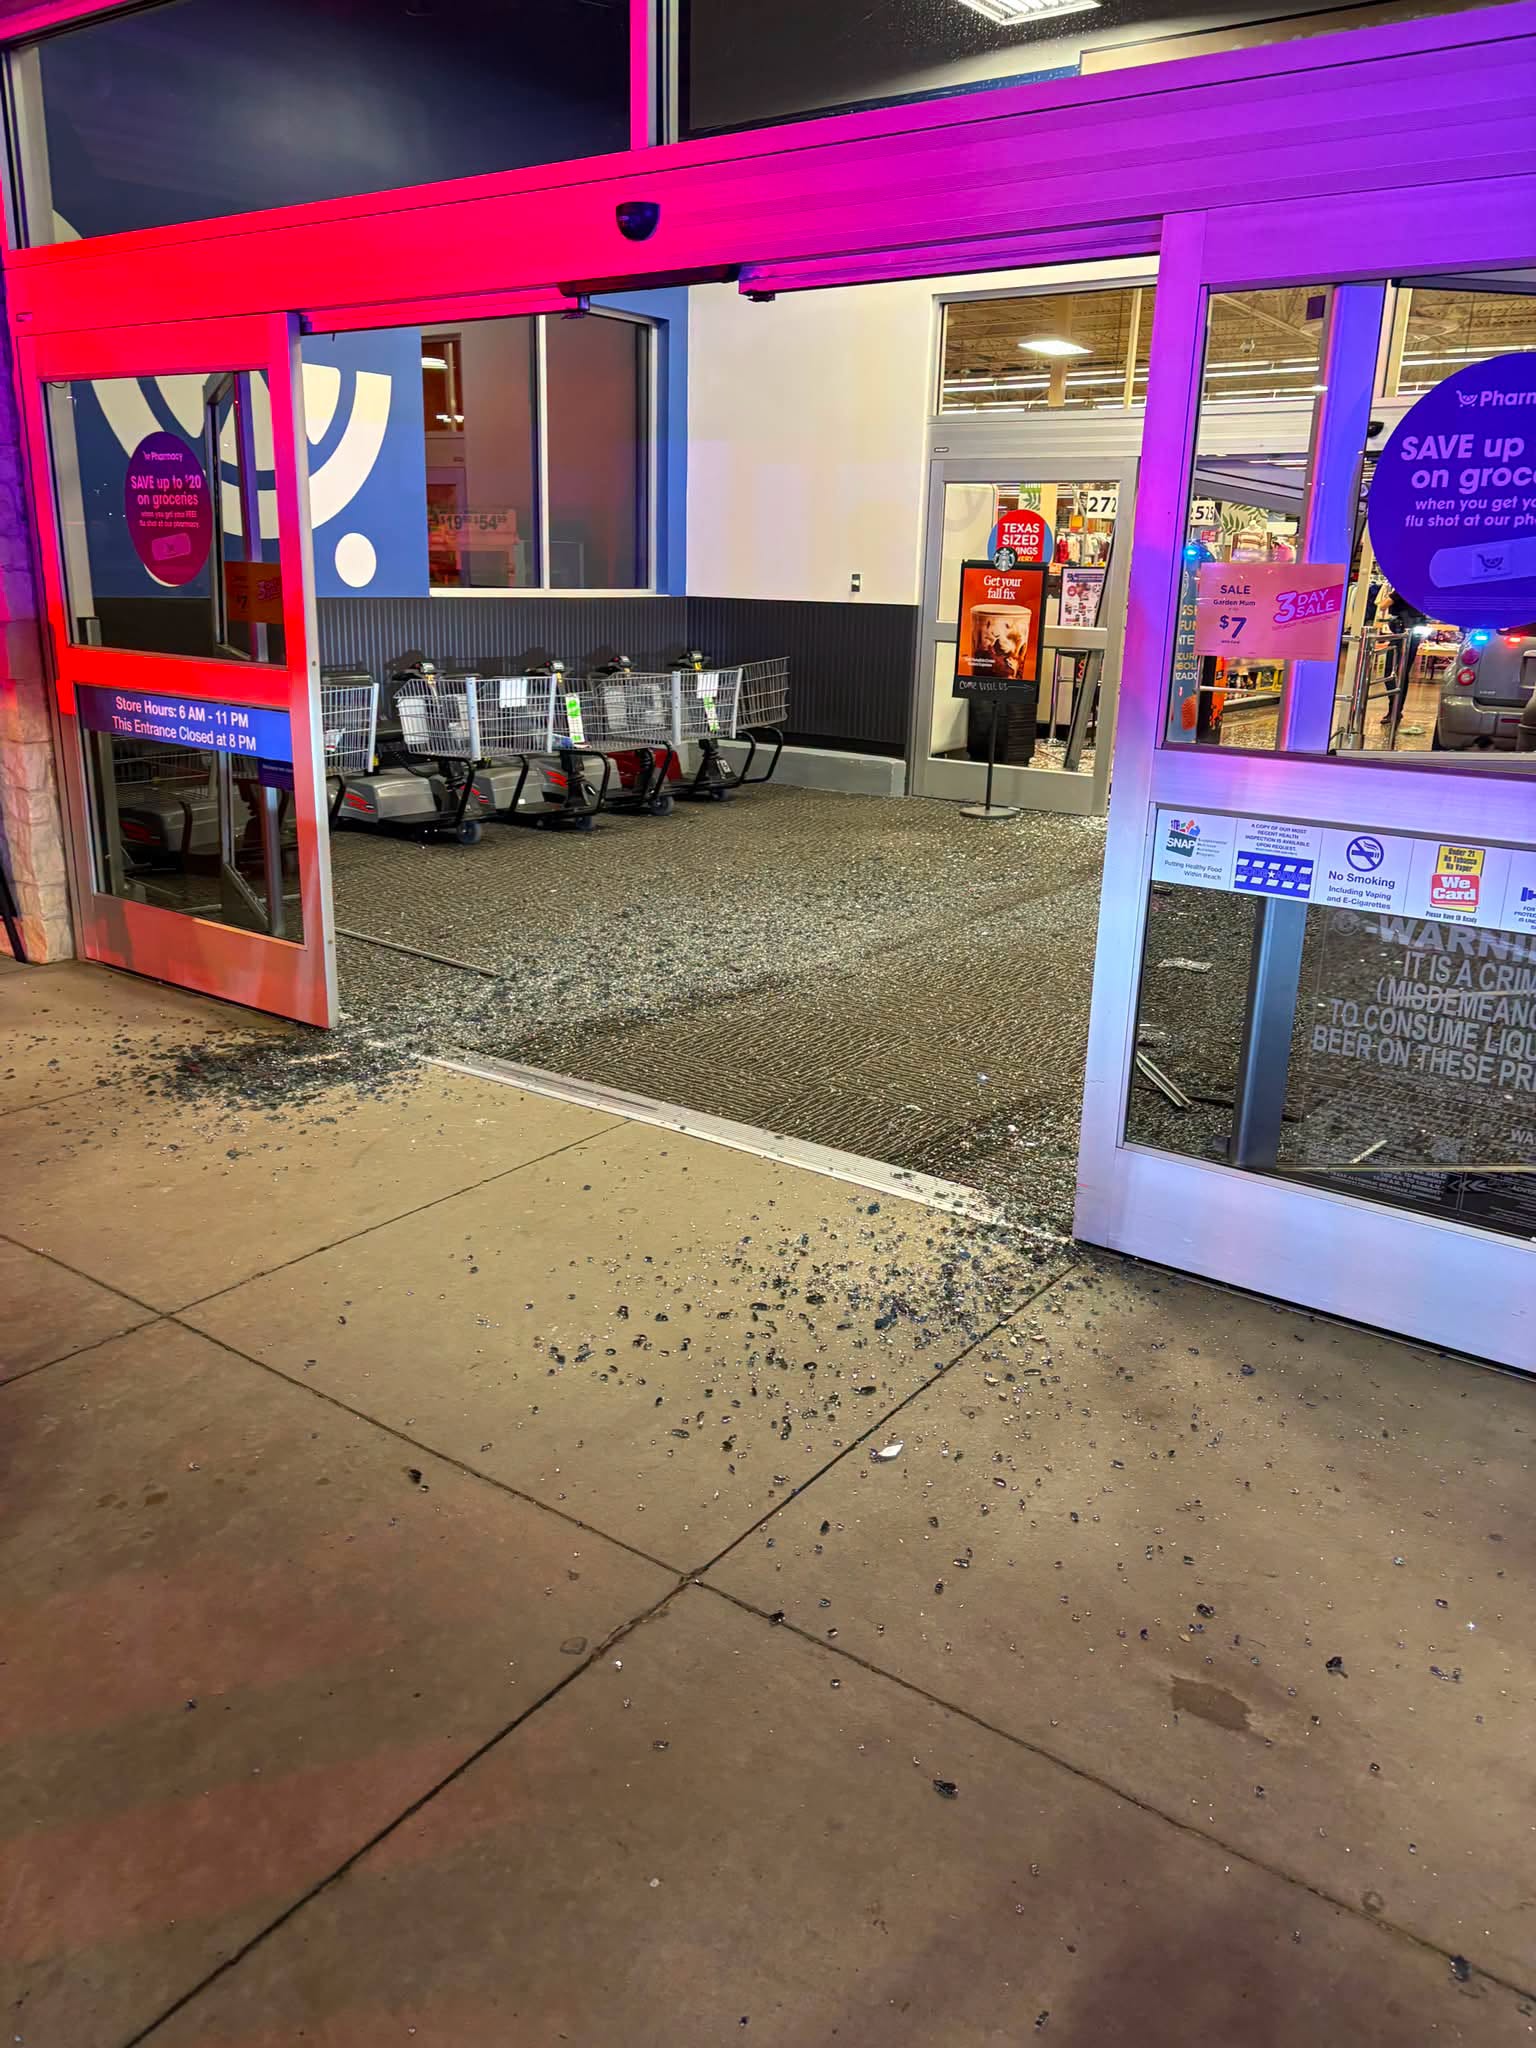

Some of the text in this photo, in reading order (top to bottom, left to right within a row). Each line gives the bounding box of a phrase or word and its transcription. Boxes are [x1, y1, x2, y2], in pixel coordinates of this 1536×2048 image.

[1401, 434, 1525, 463] SAVE up
[151, 452, 184, 463] Pharmacy
[130, 474, 202, 492] SAVE up to $20
[1411, 467, 1536, 494] on groc
[137, 491, 199, 510] on groceries
[1415, 498, 1455, 510] when
[1460, 499, 1488, 512] you
[1491, 495, 1518, 512] get
[1003, 522, 1040, 533] TEXAS
[1405, 513, 1536, 528] flu shot at our ph
[1002, 534, 1039, 546] SIZED
[1014, 546, 1038, 555] VINGS
[983, 575, 1023, 589] Get your
[1220, 585, 1251, 594] SALE
[987, 587, 1016, 600] fall fix
[1297, 589, 1329, 606] DAY
[1274, 591, 1297, 622] 3
[1296, 600, 1335, 617] SALE
[1219, 614, 1248, 639] $7
[116, 696, 142, 713] Store
[144, 700, 177, 718] Hours:
[179, 705, 185, 719] 6
[188, 707, 206, 722] AM
[216, 710, 227, 725] 11
[231, 711, 248, 728] PM
[112, 716, 256, 751] This Entrance Closed at 8 PM
[1167, 837, 1195, 849] SNAP
[1448, 848, 1467, 856] Under
[1185, 863, 1206, 872] Healthy
[1446, 862, 1454, 870] No
[1184, 870, 1202, 878] Within
[1328, 870, 1396, 890] No Smoking
[1441, 876, 1471, 889] We
[1328, 885, 1392, 901] Including Vaping
[1433, 887, 1476, 901] Card
[1326, 896, 1391, 910] and E-Cigarettes
[1462, 915, 1477, 923] Ready
[1404, 951, 1425, 979] IT
[1429, 954, 1450, 984] IS
[1454, 959, 1472, 987] A
[1330, 999, 1358, 1028] TO
[1364, 1004, 1480, 1050] CONSUME
[1312, 1024, 1373, 1060] BEER
[1378, 1037, 1411, 1068] ON
[1416, 1044, 1496, 1083] THESE
